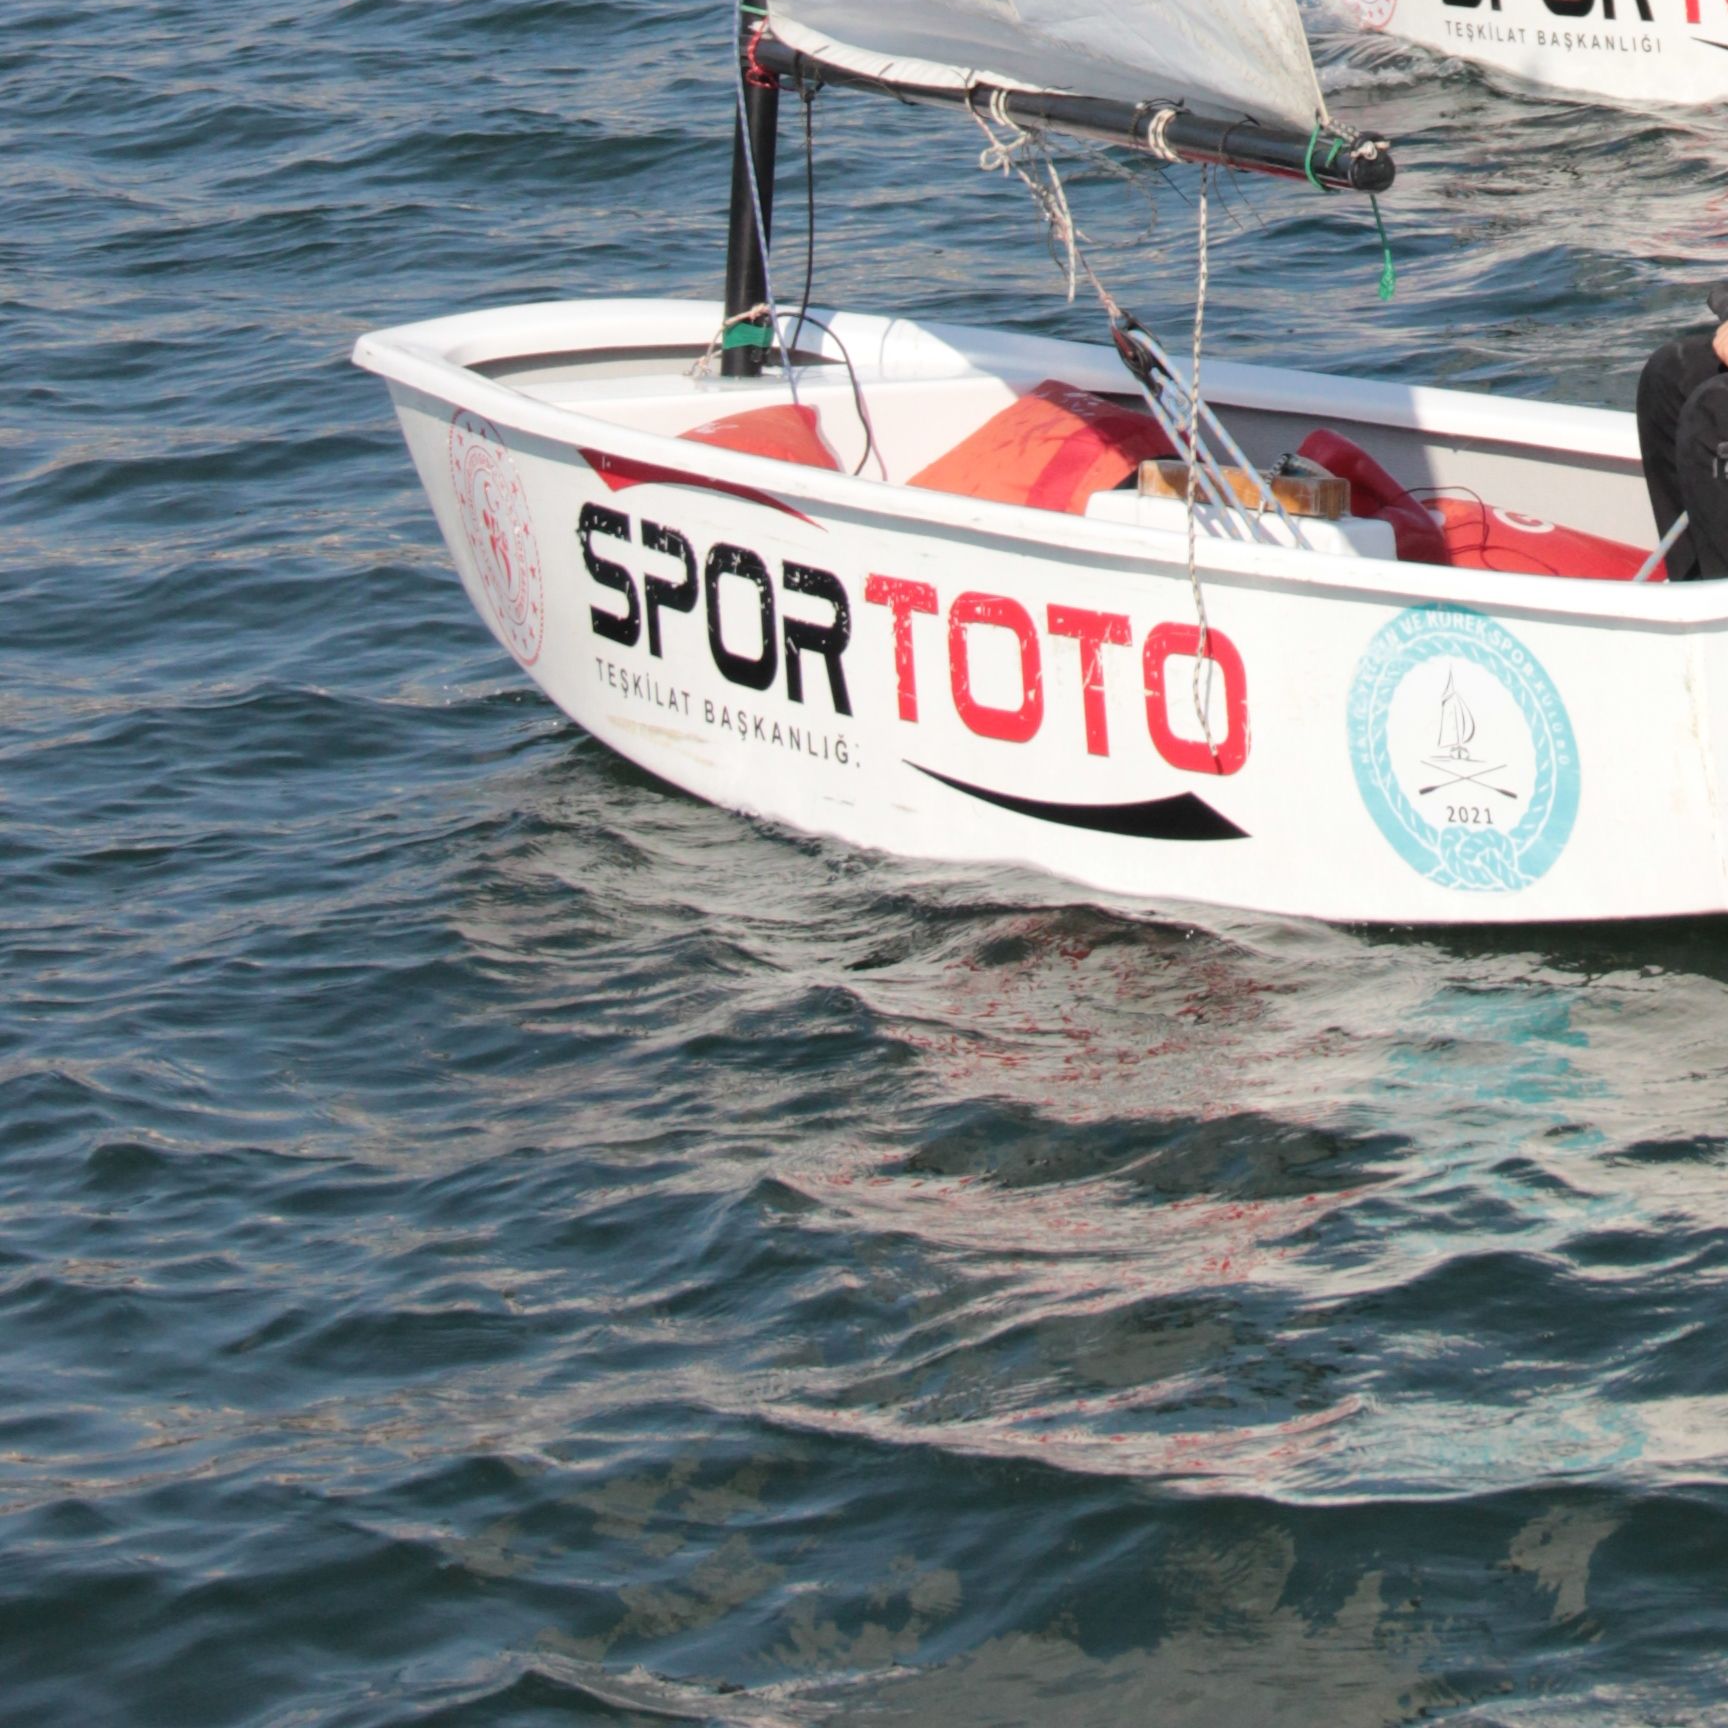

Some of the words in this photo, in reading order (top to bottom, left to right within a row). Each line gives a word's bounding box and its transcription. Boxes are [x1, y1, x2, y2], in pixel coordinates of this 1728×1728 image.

[1444, 20, 1527, 45] TEŞKİLAT
[1537, 28, 1663, 54] BAŞKANLIĞI
[595, 656, 691, 716] TEŞKİLAT
[703, 698, 861, 769] BAŞKANLIĞ
[1446, 805, 1495, 826] 2021
